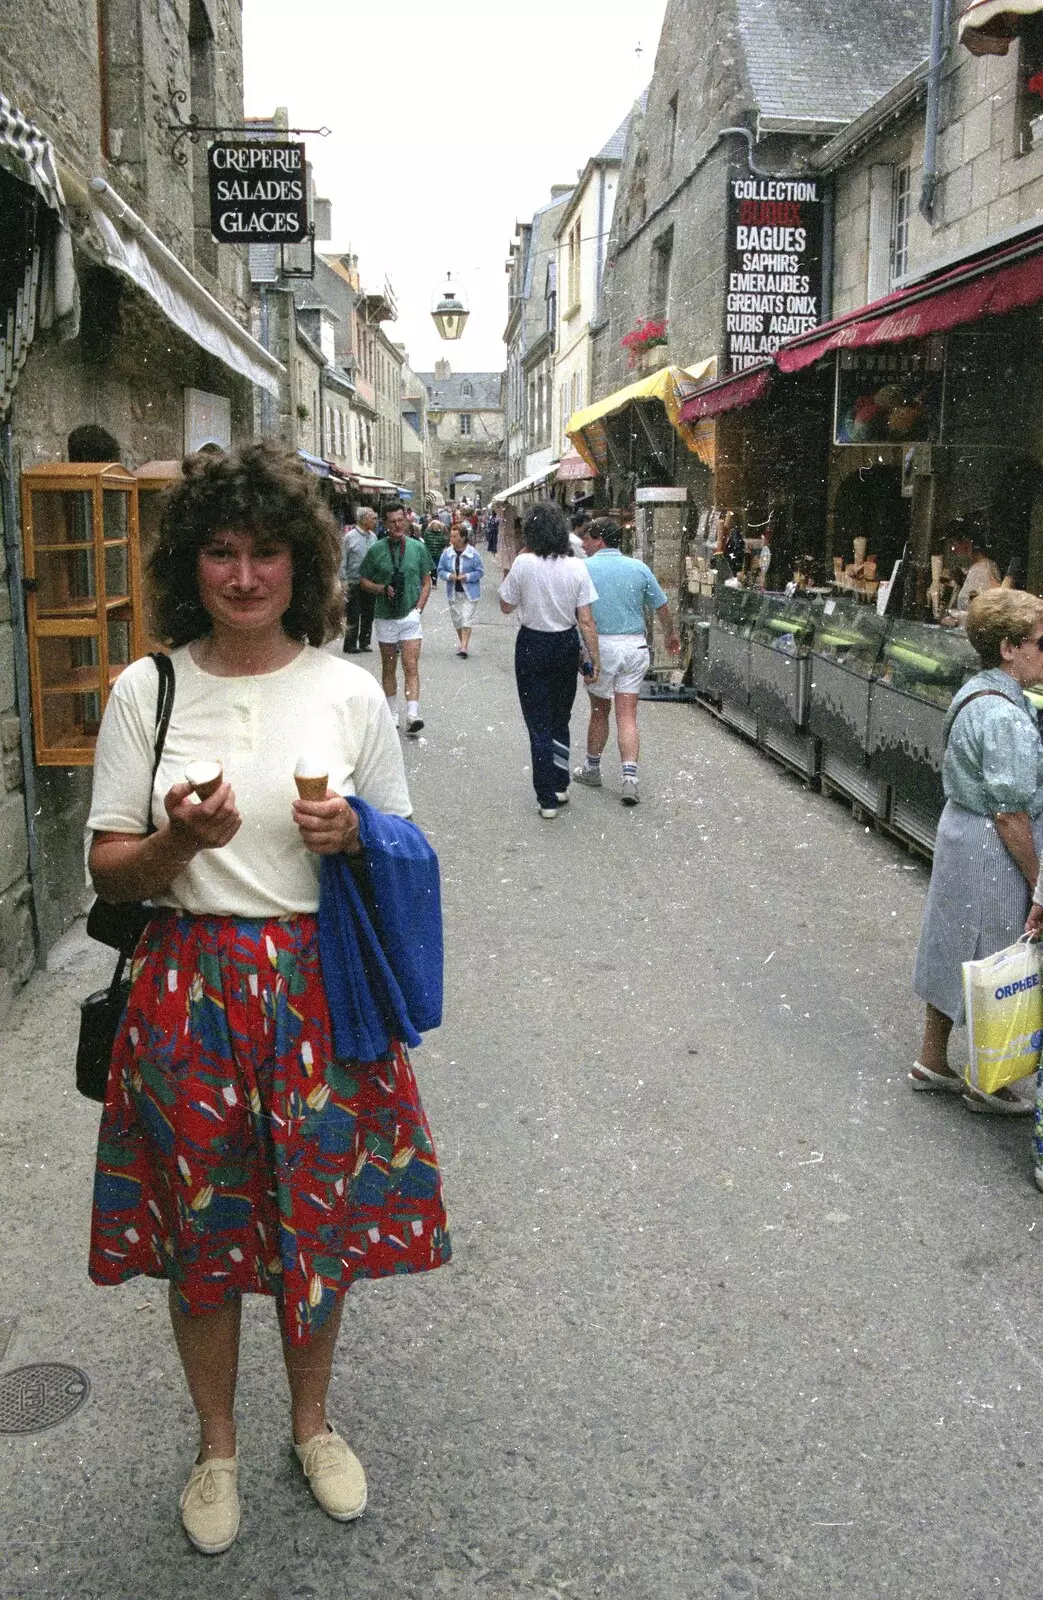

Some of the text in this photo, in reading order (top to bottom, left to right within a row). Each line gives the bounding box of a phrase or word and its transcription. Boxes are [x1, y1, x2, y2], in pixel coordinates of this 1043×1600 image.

[213, 149, 301, 172] CREPERIE
[217, 180, 303, 200] SALADES
[220, 212, 299, 232] GLACES
[736, 226, 806, 252] BAGUES
[743, 254, 798, 273] SAPHIRS
[730, 273, 809, 293] EMERAUDES
[727, 294, 817, 314] GRENATS ONIX
[727, 315, 817, 334] RUBIS AGATES
[995, 974, 1040, 999] ORPHEE
